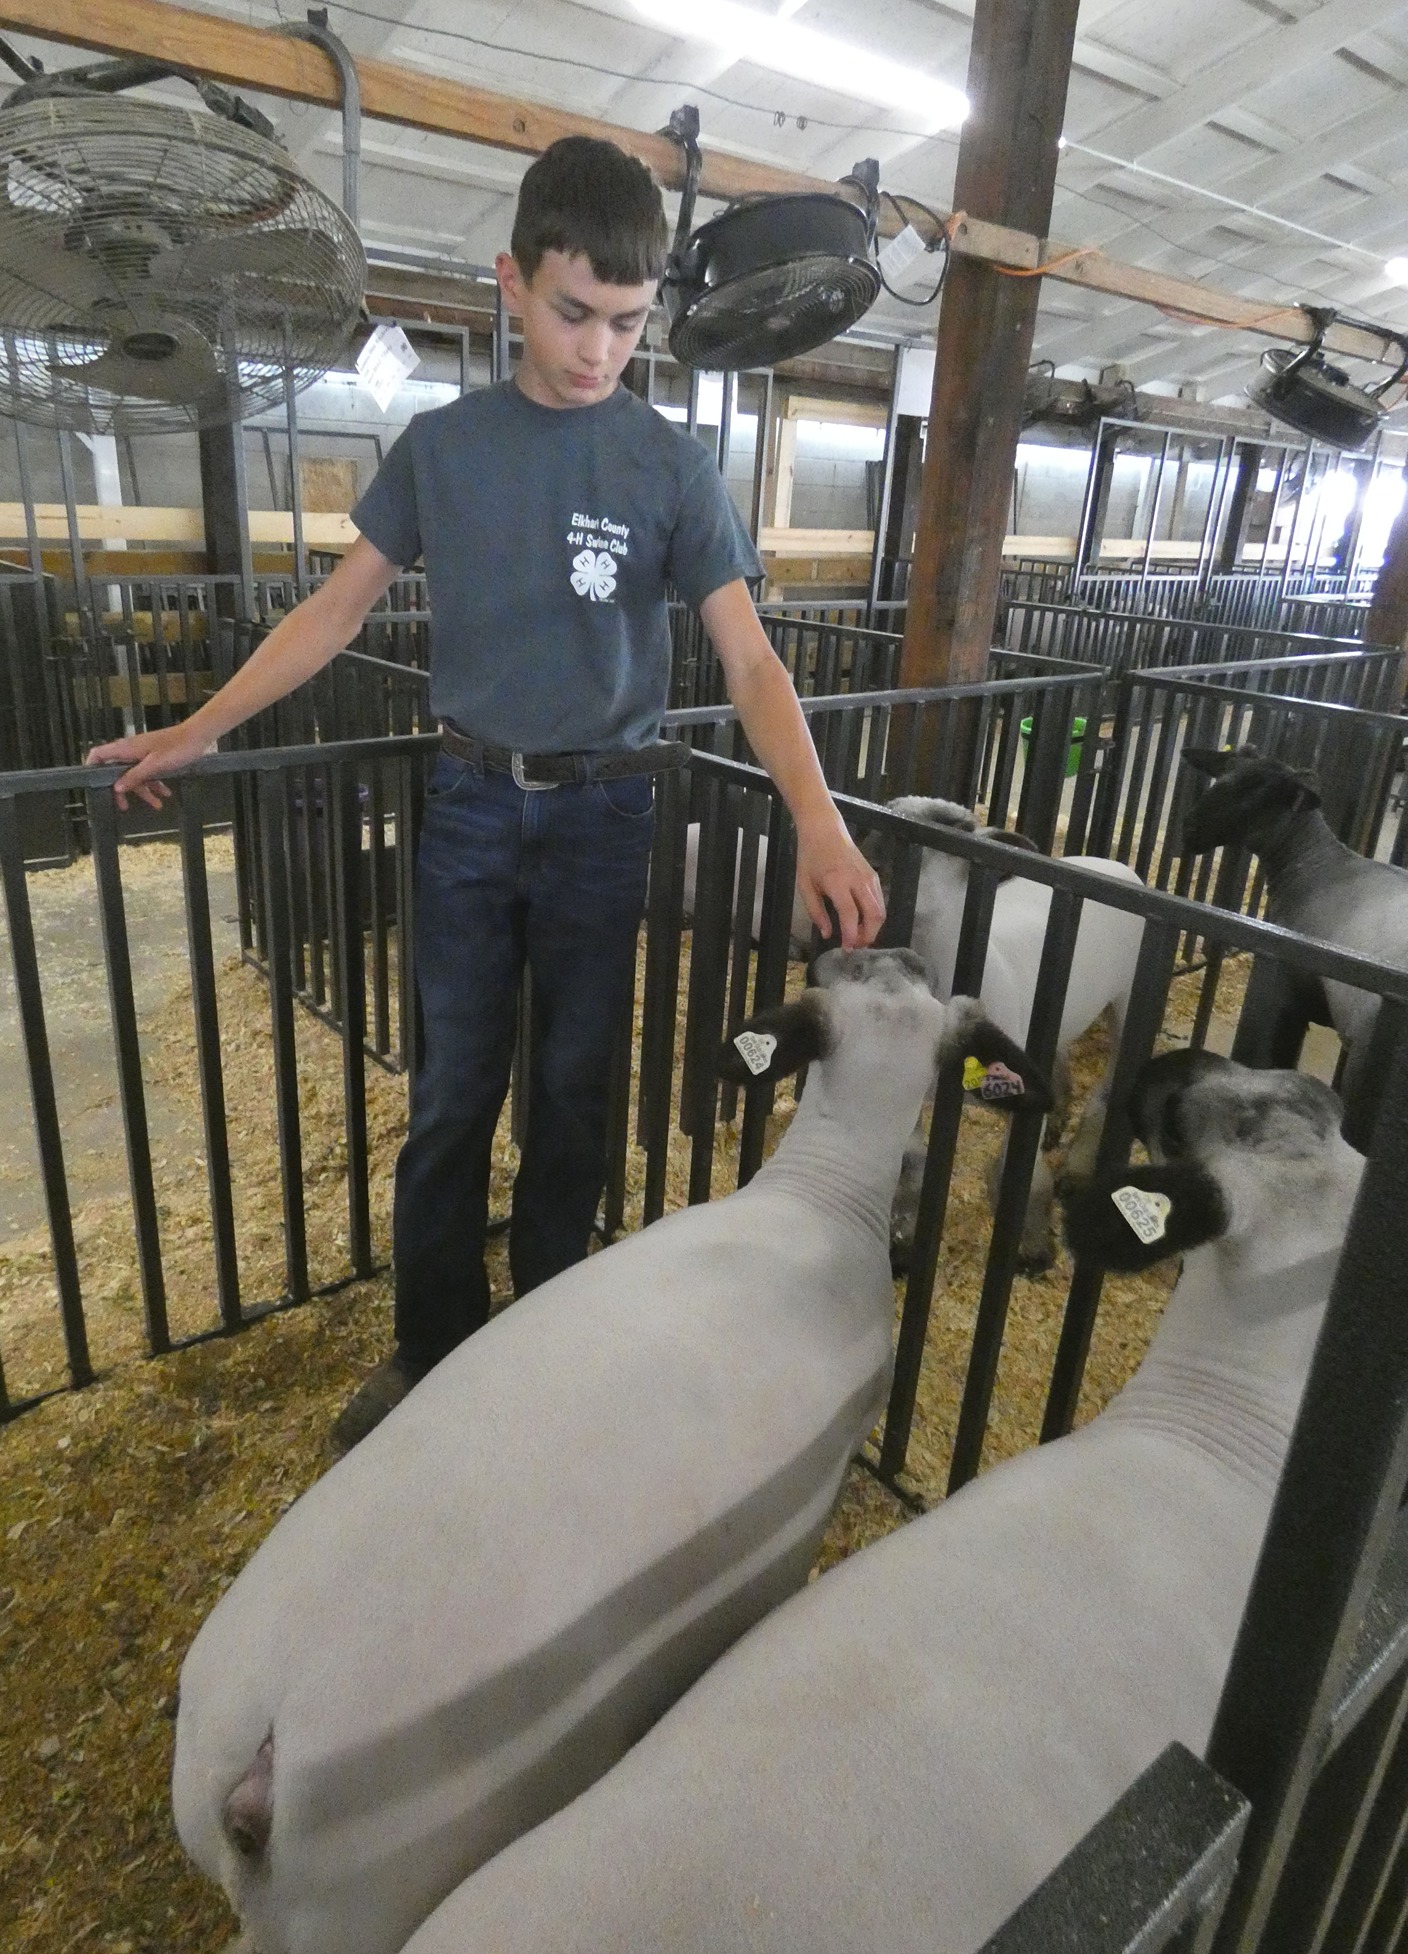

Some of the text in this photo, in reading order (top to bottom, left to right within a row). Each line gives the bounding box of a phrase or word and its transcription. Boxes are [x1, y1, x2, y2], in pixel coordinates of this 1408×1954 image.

[601, 517, 630, 539] County
[566, 531, 584, 545] 4-H
[610, 538, 628, 556] Club
[740, 1036, 764, 1069] 00624
[1119, 1192, 1157, 1237] 00625
